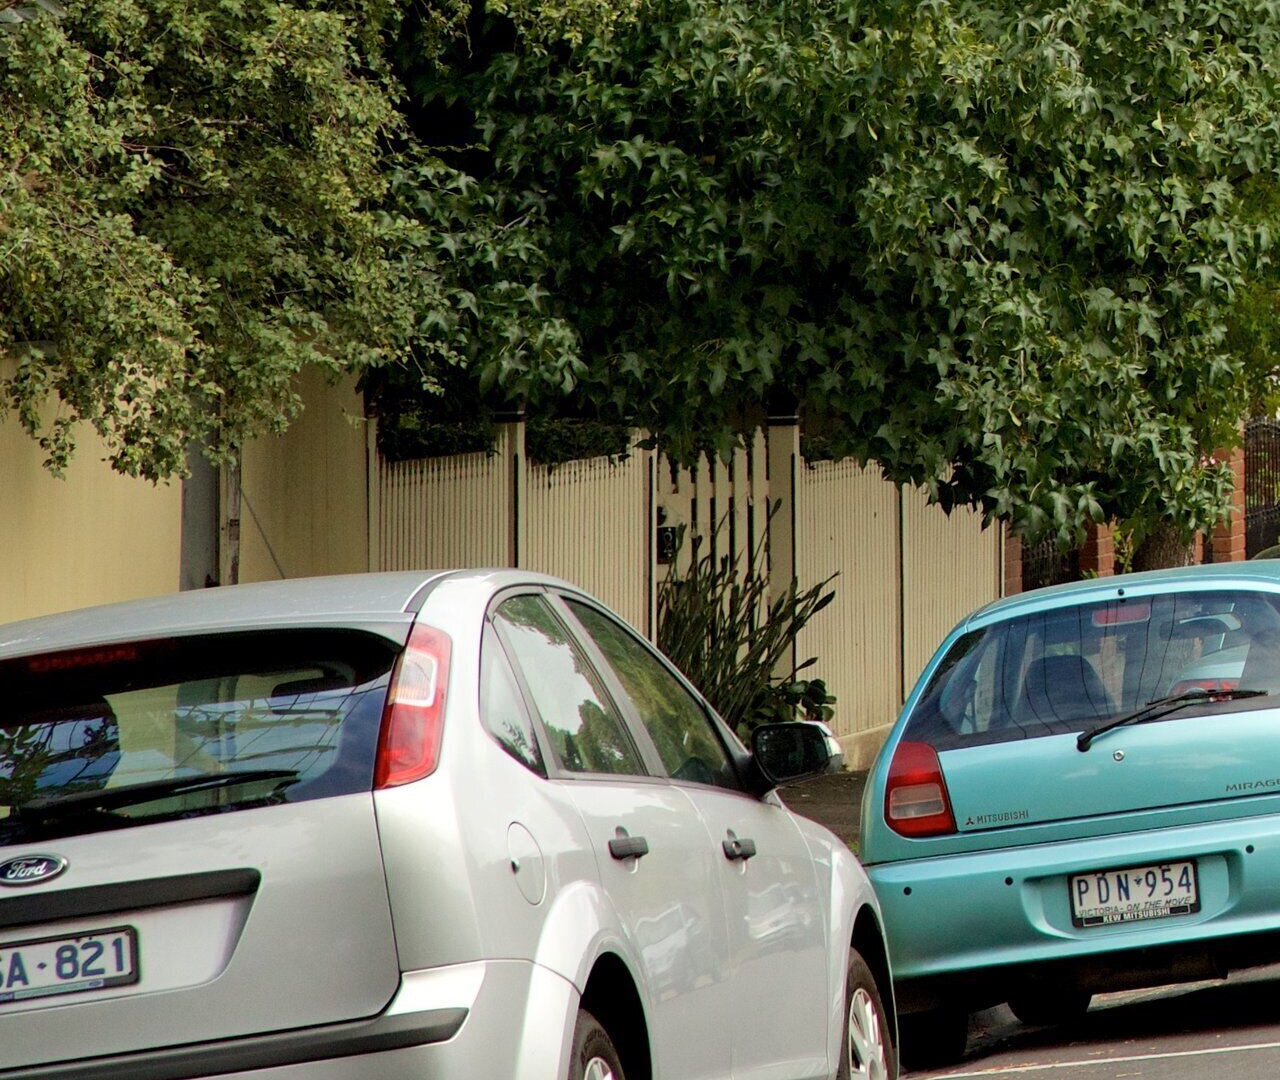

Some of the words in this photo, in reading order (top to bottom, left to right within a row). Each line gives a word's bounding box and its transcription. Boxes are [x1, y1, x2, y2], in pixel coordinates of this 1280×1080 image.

[976, 810, 1030, 824] MITSUBISHI
[6, 859, 48, 879] Ford
[1077, 873, 1131, 907] PDN
[1145, 865, 1192, 898] 954
[1126, 903, 1140, 911] ON
[1143, 899, 1162, 909] THE
[1164, 895, 1192, 906] MOVE
[1103, 914, 1122, 923] KEW
[1123, 908, 1171, 920] MITSUBISHI
[0, 952, 29, 988] A
[55, 937, 124, 980] 821
